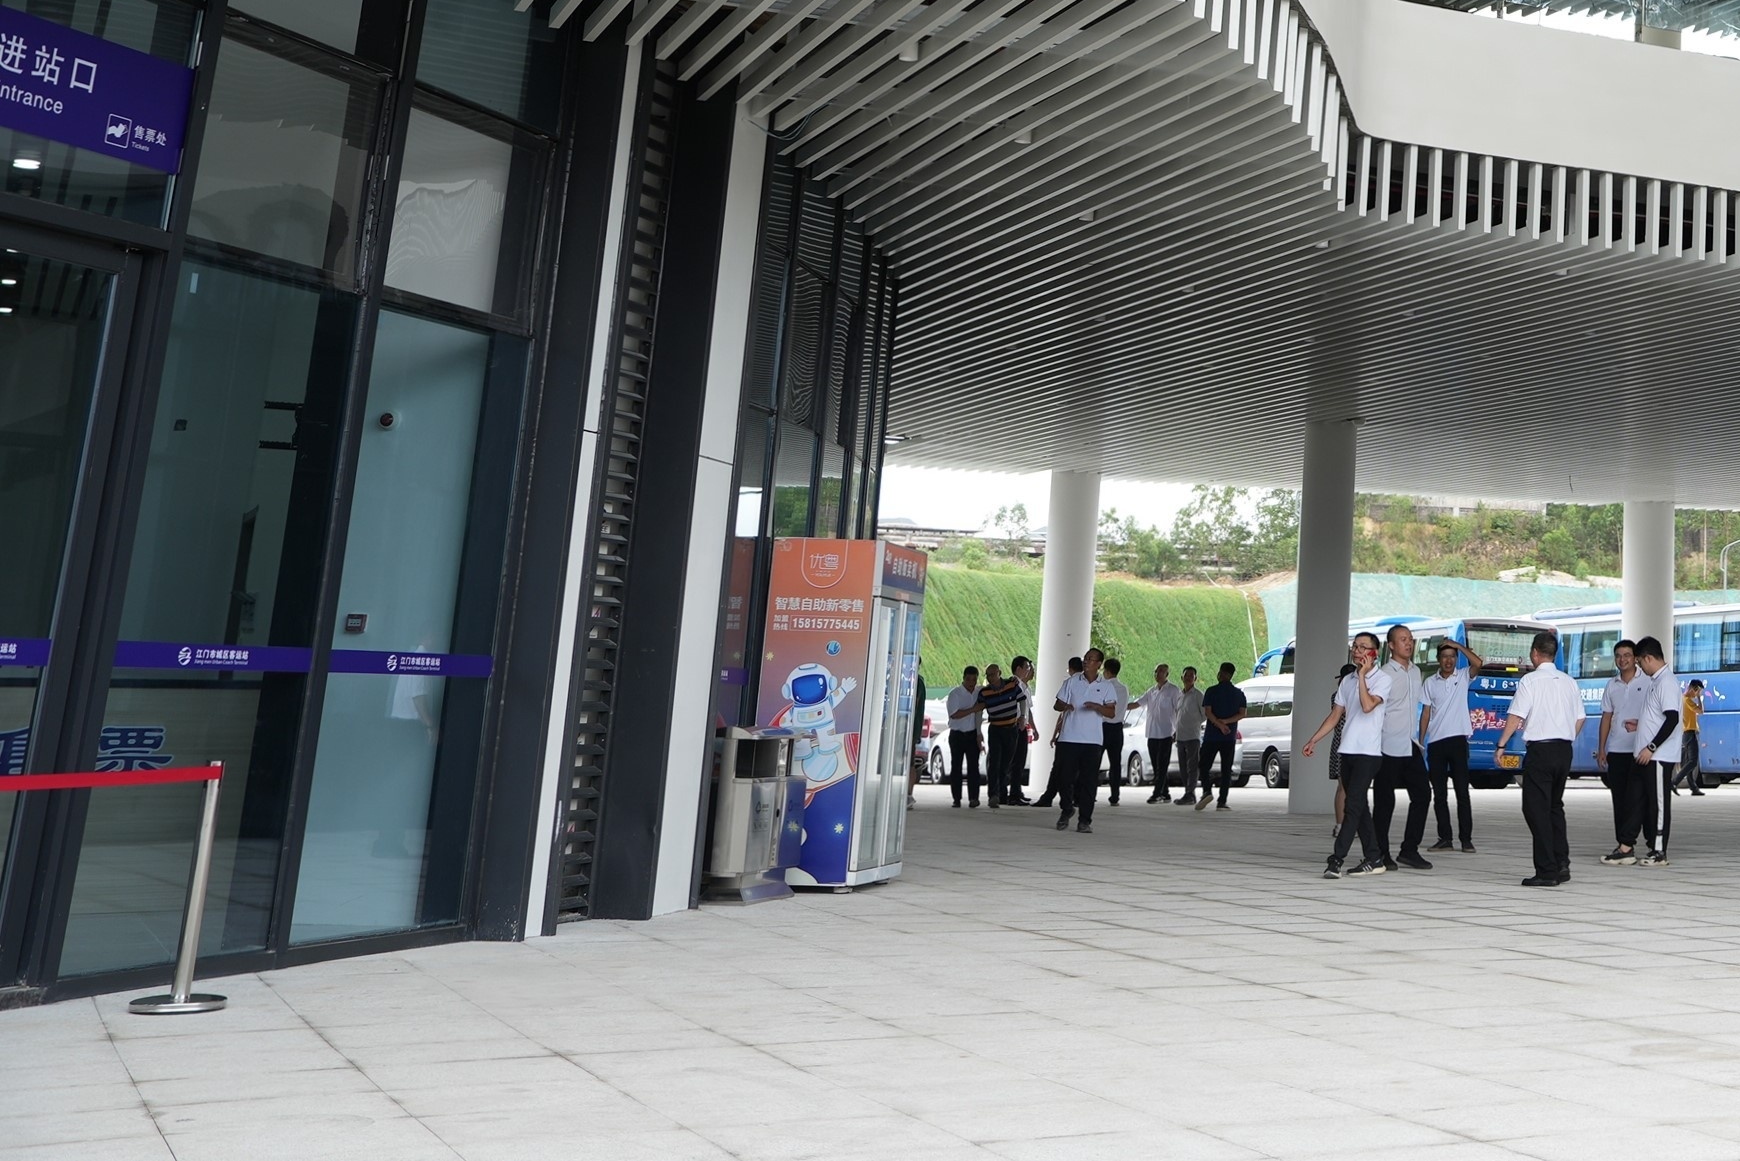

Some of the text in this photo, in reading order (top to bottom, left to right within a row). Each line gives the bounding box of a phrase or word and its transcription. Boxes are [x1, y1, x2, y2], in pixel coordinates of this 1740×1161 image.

[0, 33, 98, 94] 进站口
[0, 80, 64, 115] ntrance
[134, 124, 168, 147] 售票处
[775, 596, 865, 613] 智慧自助新零售
[792, 617, 860, 630] 15815775445
